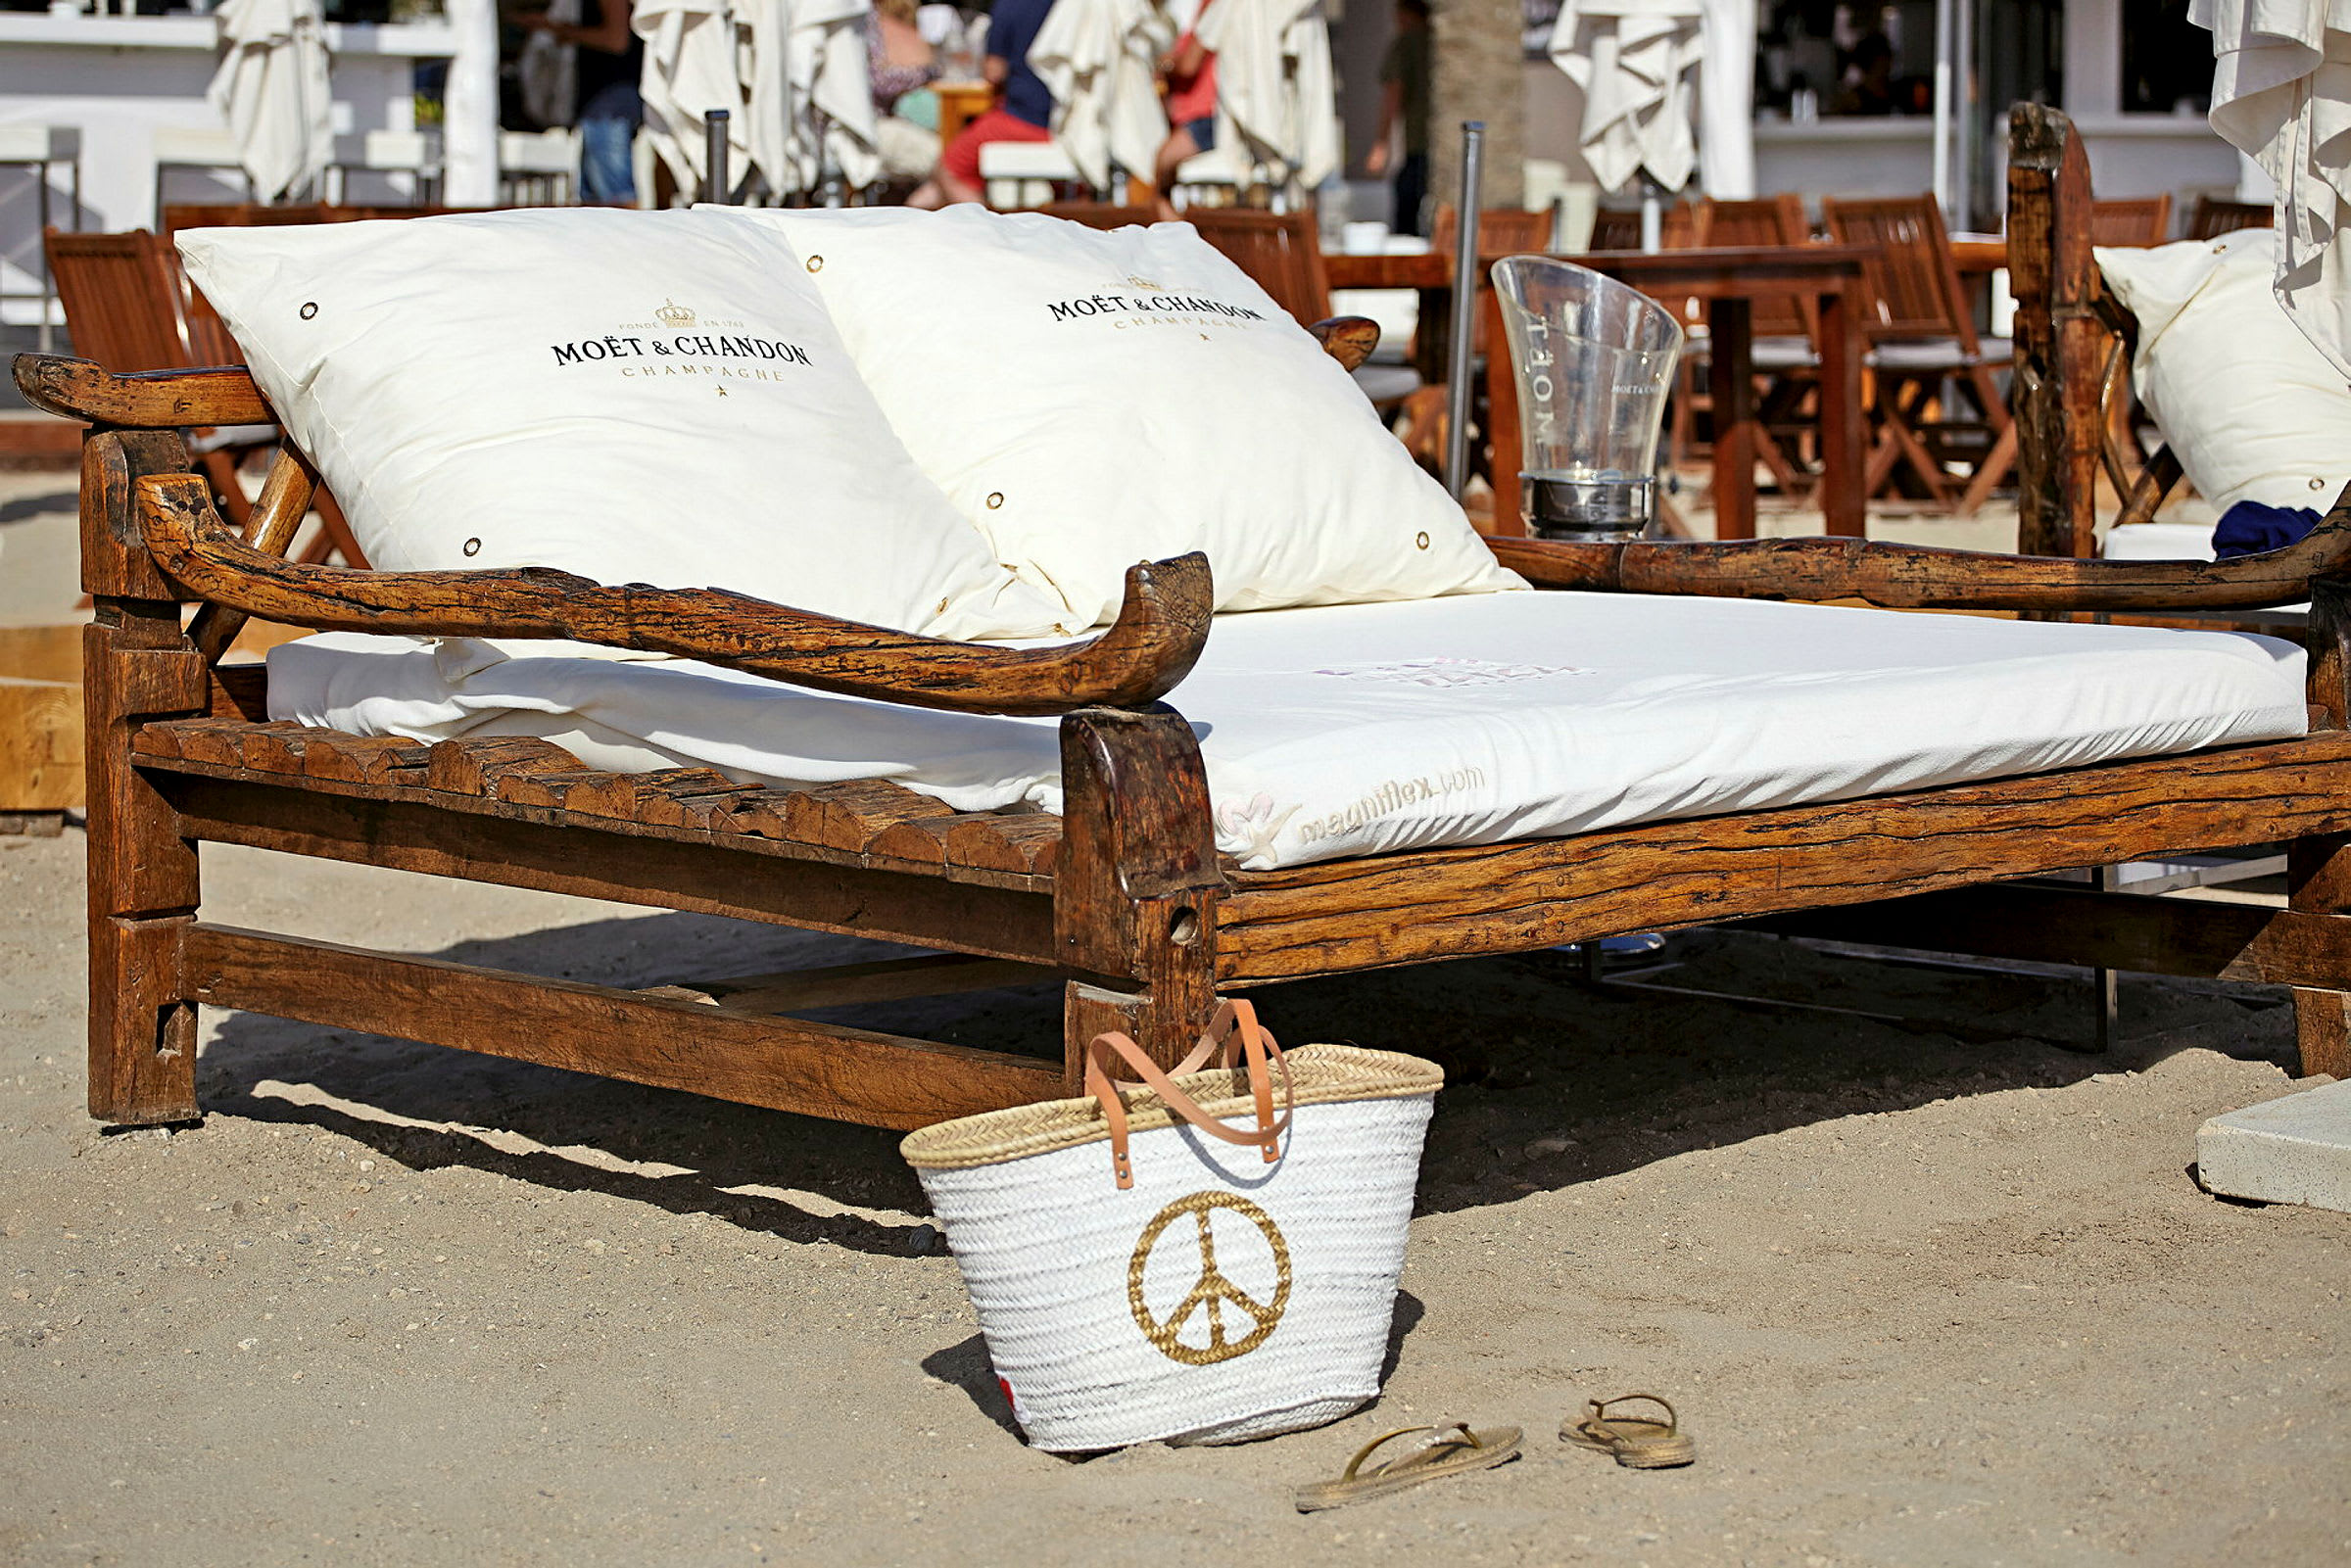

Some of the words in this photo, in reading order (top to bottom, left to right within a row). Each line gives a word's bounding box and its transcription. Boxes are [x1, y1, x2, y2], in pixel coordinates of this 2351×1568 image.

[1047, 295, 1129, 322] MOËT
[1133, 298, 1153, 311] &
[1152, 296, 1267, 321] CHANDON
[552, 335, 644, 366] MOËT
[651, 341, 674, 356] &
[675, 335, 814, 367] CHANDON
[622, 364, 784, 382] CHAMPAGNE
